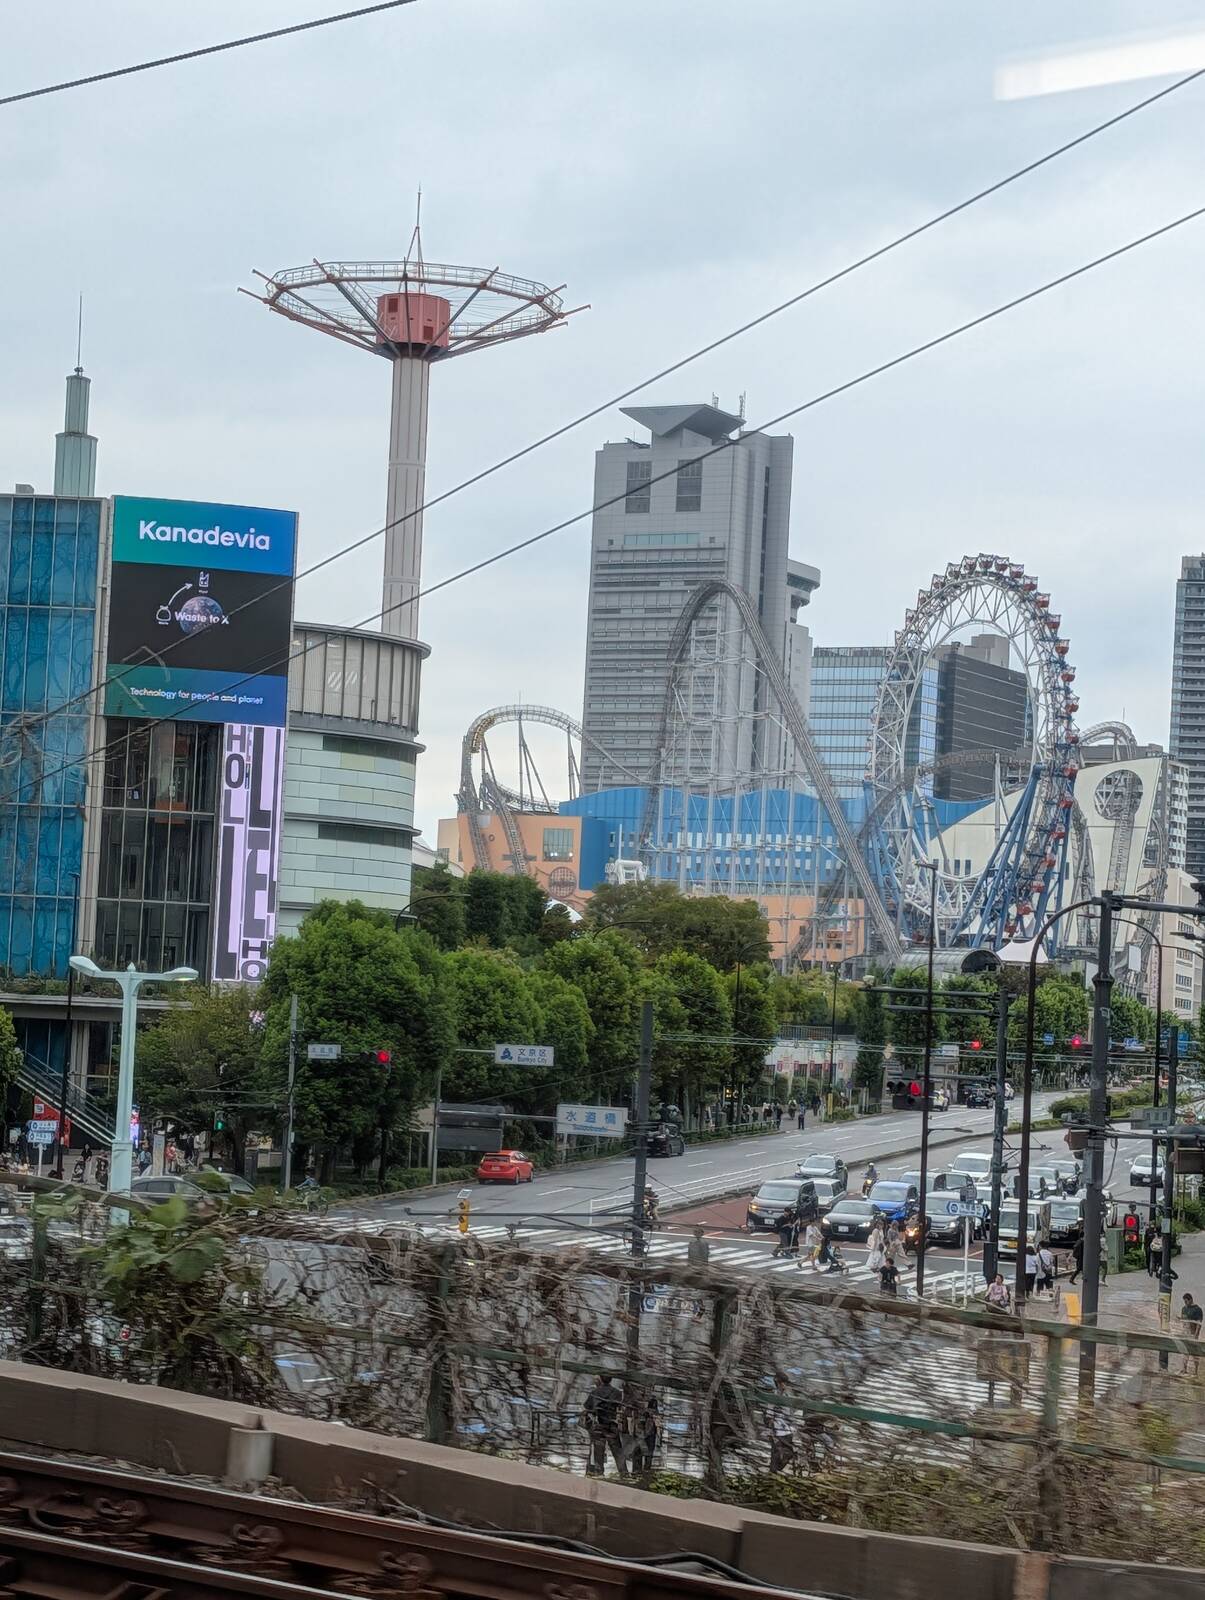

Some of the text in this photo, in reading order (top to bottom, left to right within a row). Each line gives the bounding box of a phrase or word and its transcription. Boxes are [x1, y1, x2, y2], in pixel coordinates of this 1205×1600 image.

[139, 519, 270, 550] Kanadevia
[174, 611, 207, 623] Waste
[209, 614, 220, 624] to
[130, 687, 263, 705] Technology for people and planet
[517, 1048, 547, 1058] 文京区
